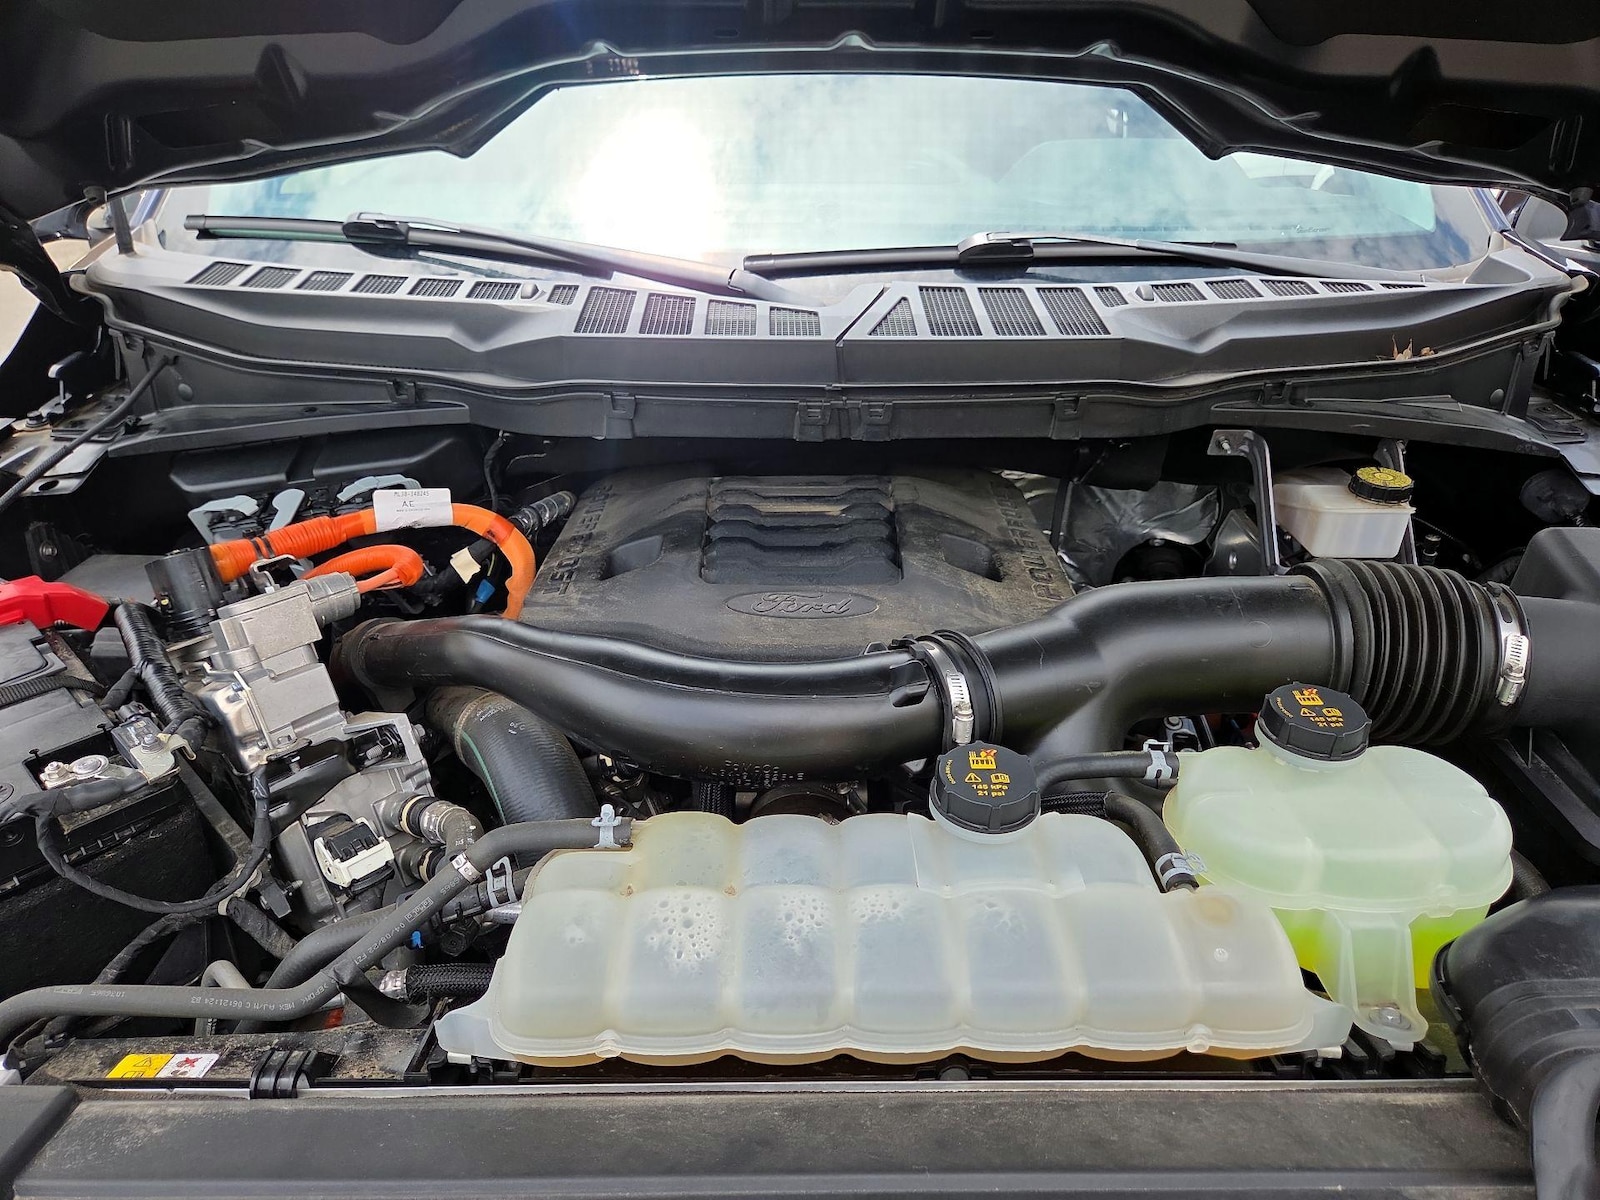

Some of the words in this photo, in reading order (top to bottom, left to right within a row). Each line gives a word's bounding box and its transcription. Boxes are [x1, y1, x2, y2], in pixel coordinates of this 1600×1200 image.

[751, 593, 852, 615] Ford
[367, 922, 406, 954] 04/08/22
[279, 1002, 295, 1011] MEX
